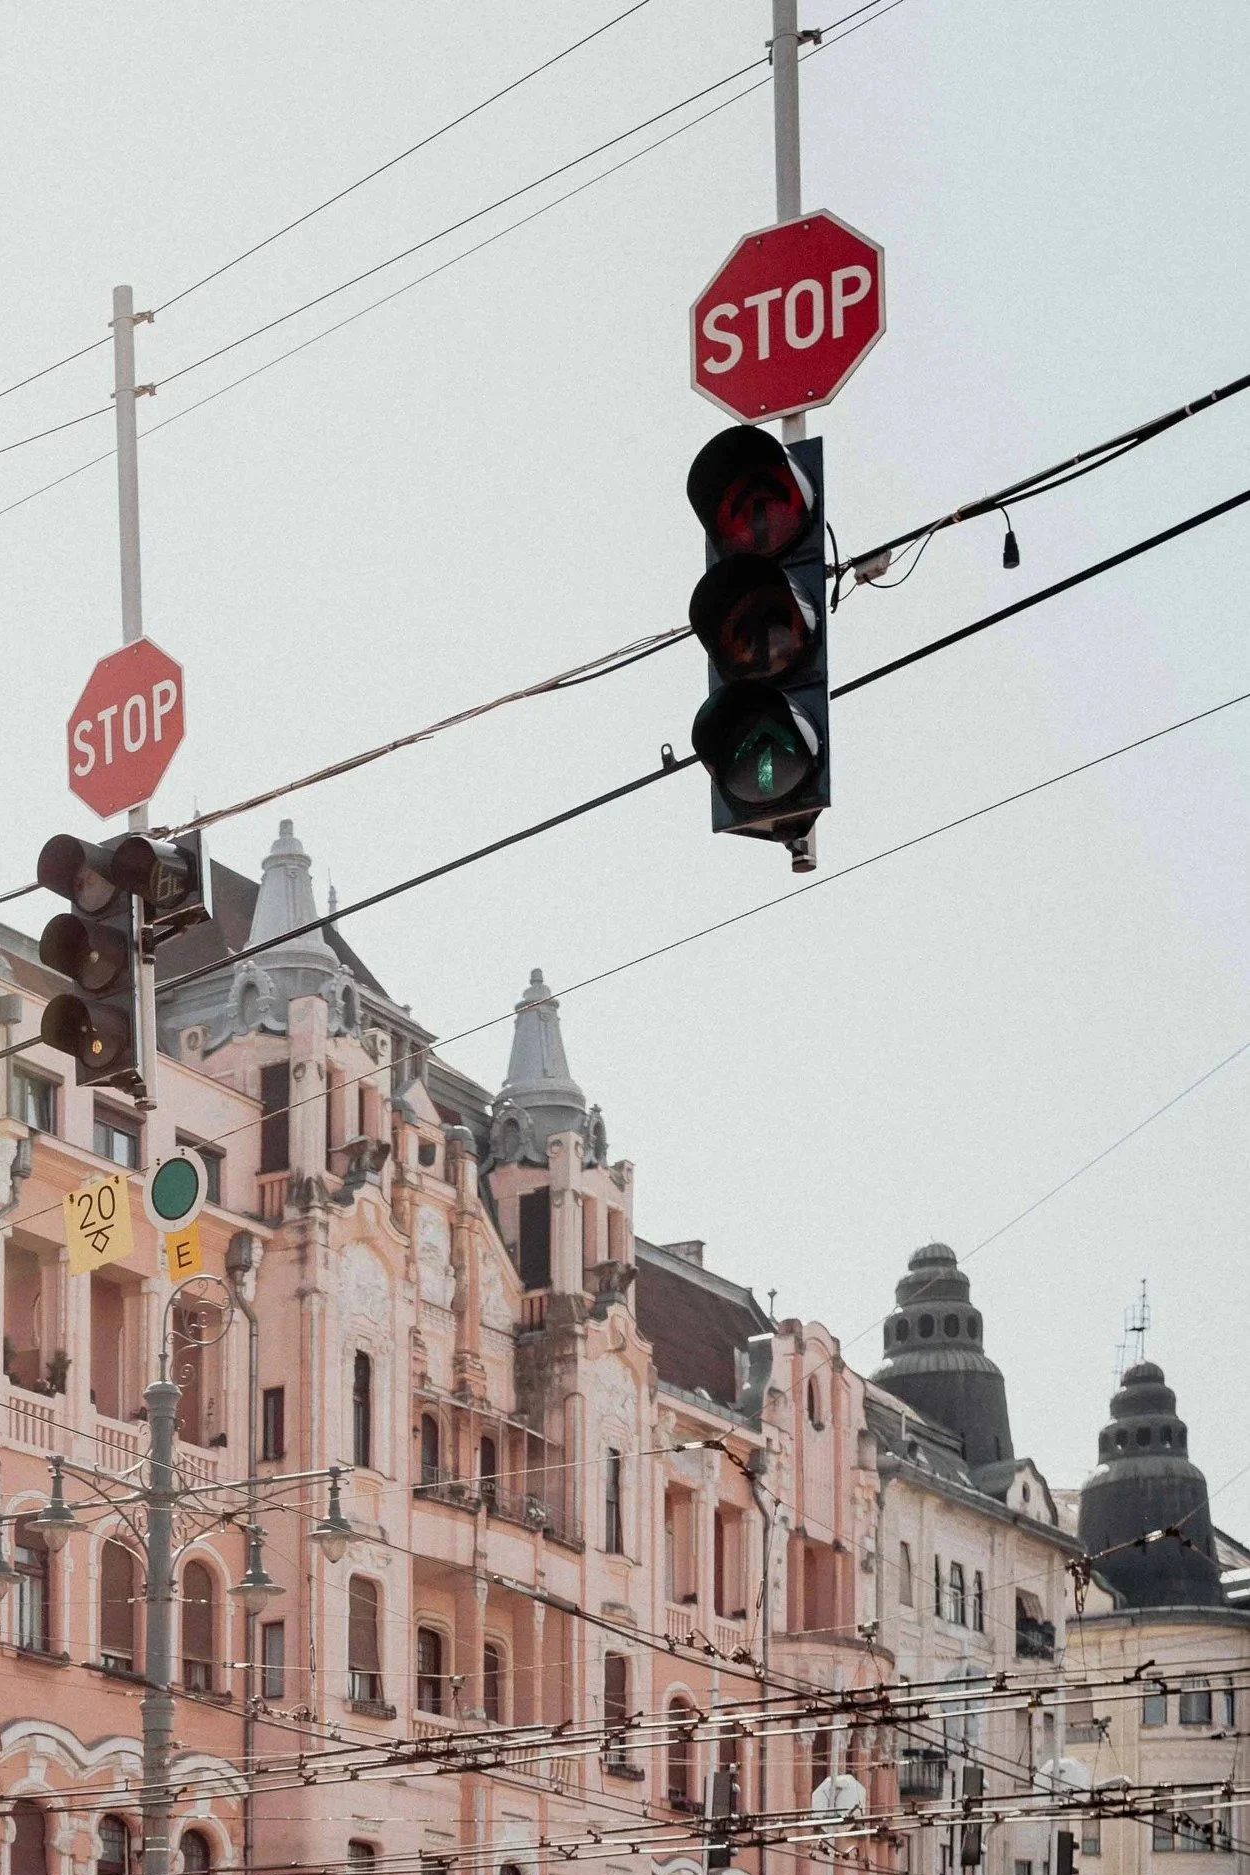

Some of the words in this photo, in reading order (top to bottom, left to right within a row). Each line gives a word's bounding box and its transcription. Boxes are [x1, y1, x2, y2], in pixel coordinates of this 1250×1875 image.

[702, 265, 872, 374] STOP
[73, 679, 178, 777] STOP
[77, 1185, 116, 1231] 20
[176, 1241, 193, 1269] E
